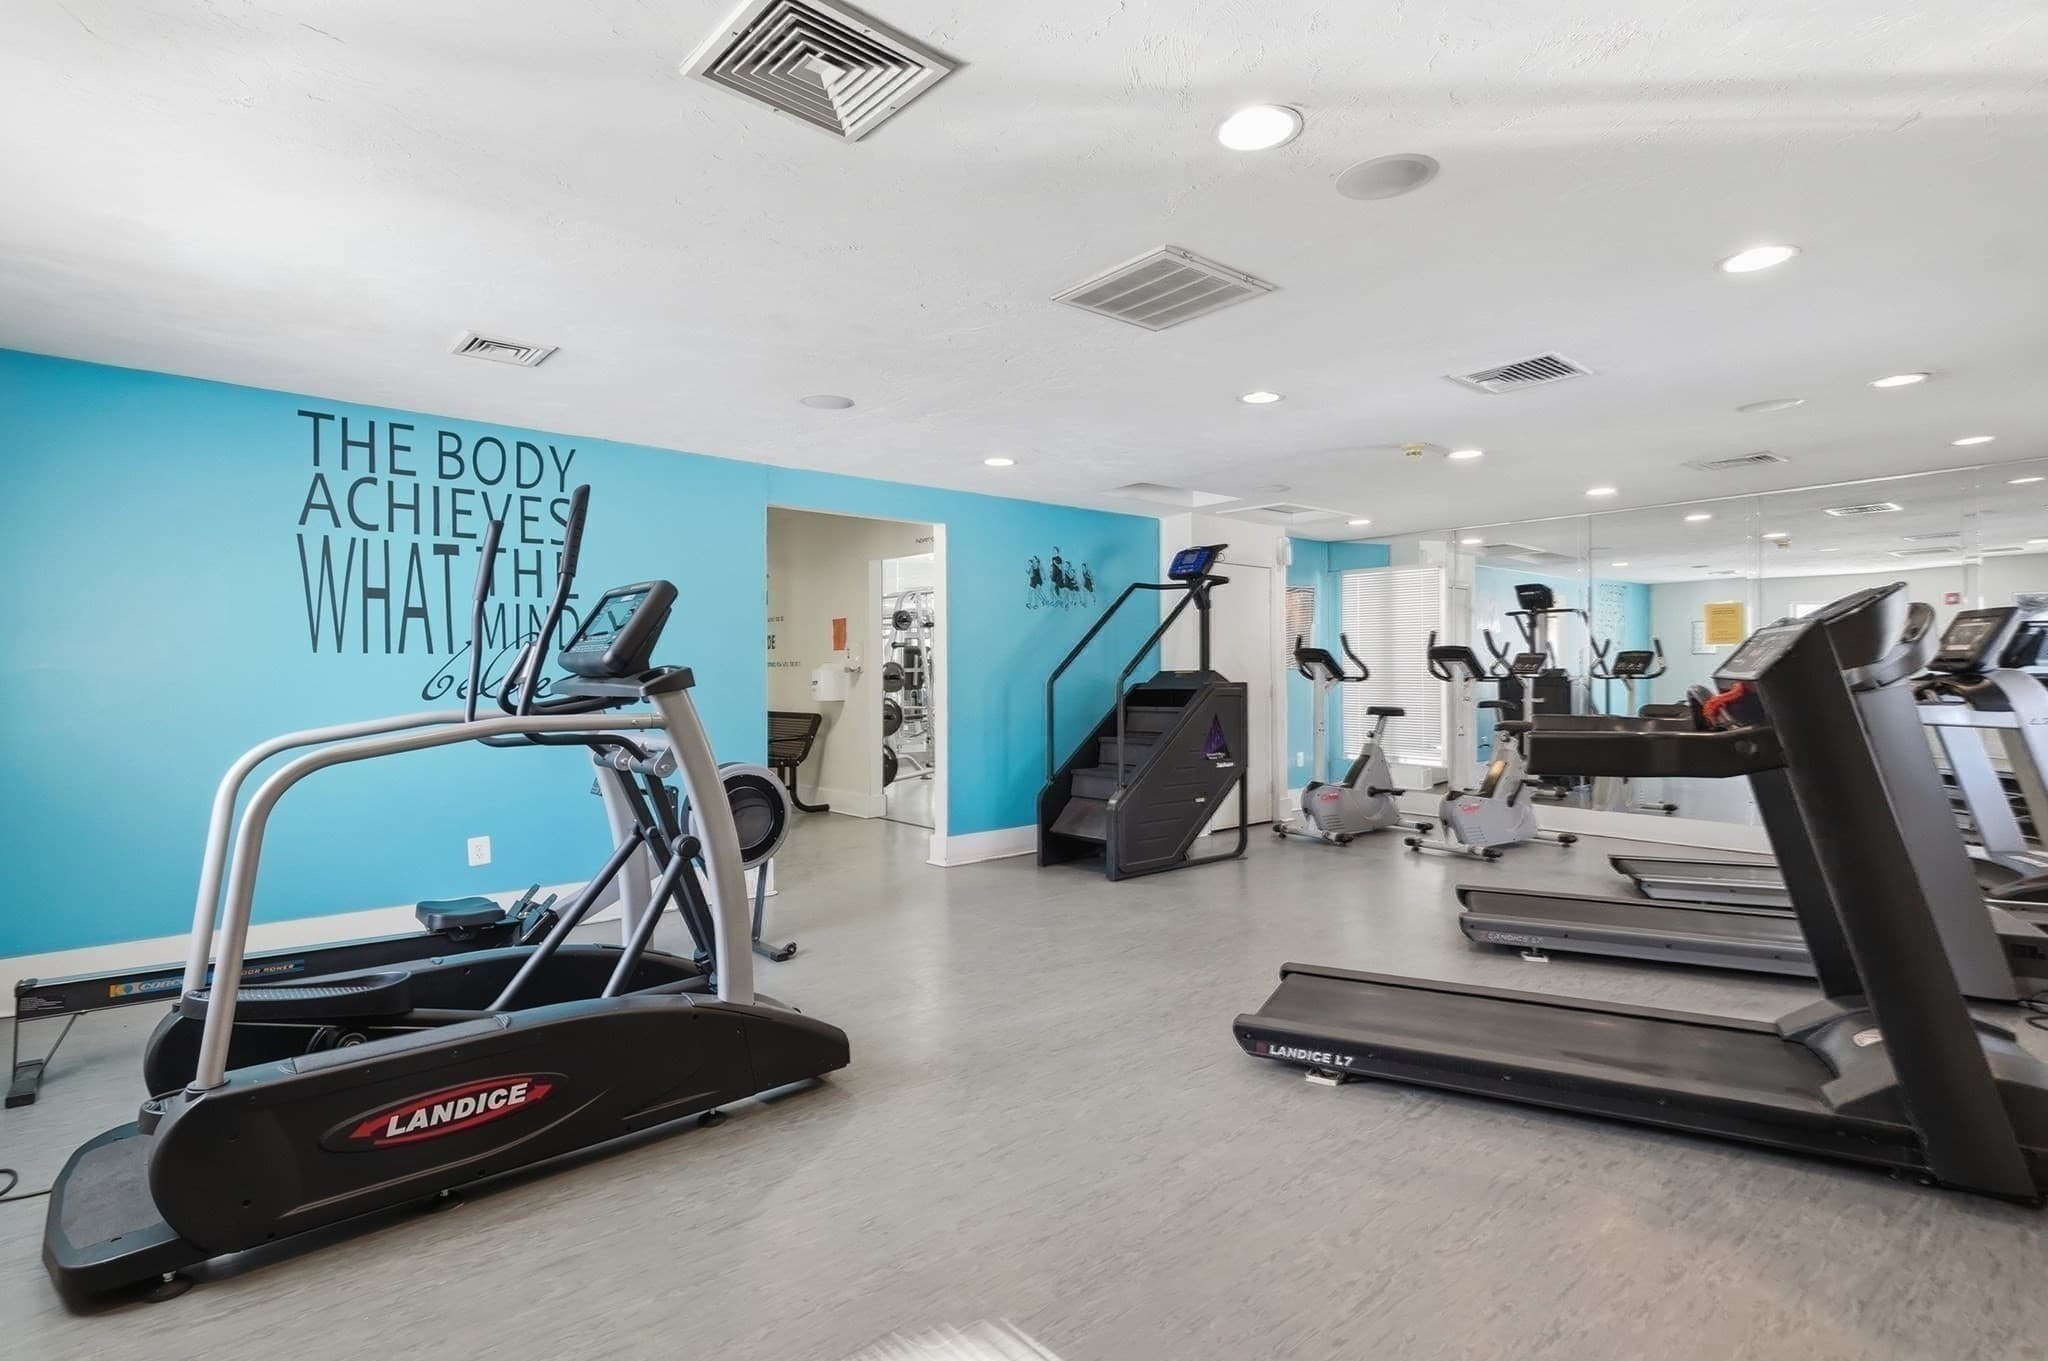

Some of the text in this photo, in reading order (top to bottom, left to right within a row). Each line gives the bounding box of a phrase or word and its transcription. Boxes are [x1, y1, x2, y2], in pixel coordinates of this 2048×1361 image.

[297, 409, 577, 493] THE BODY
[298, 473, 571, 547] ACHIEVES
[297, 533, 460, 655] WHAT
[1268, 1044, 1353, 1067] LANDICE L7
[385, 1082, 529, 1138] LANDICE
